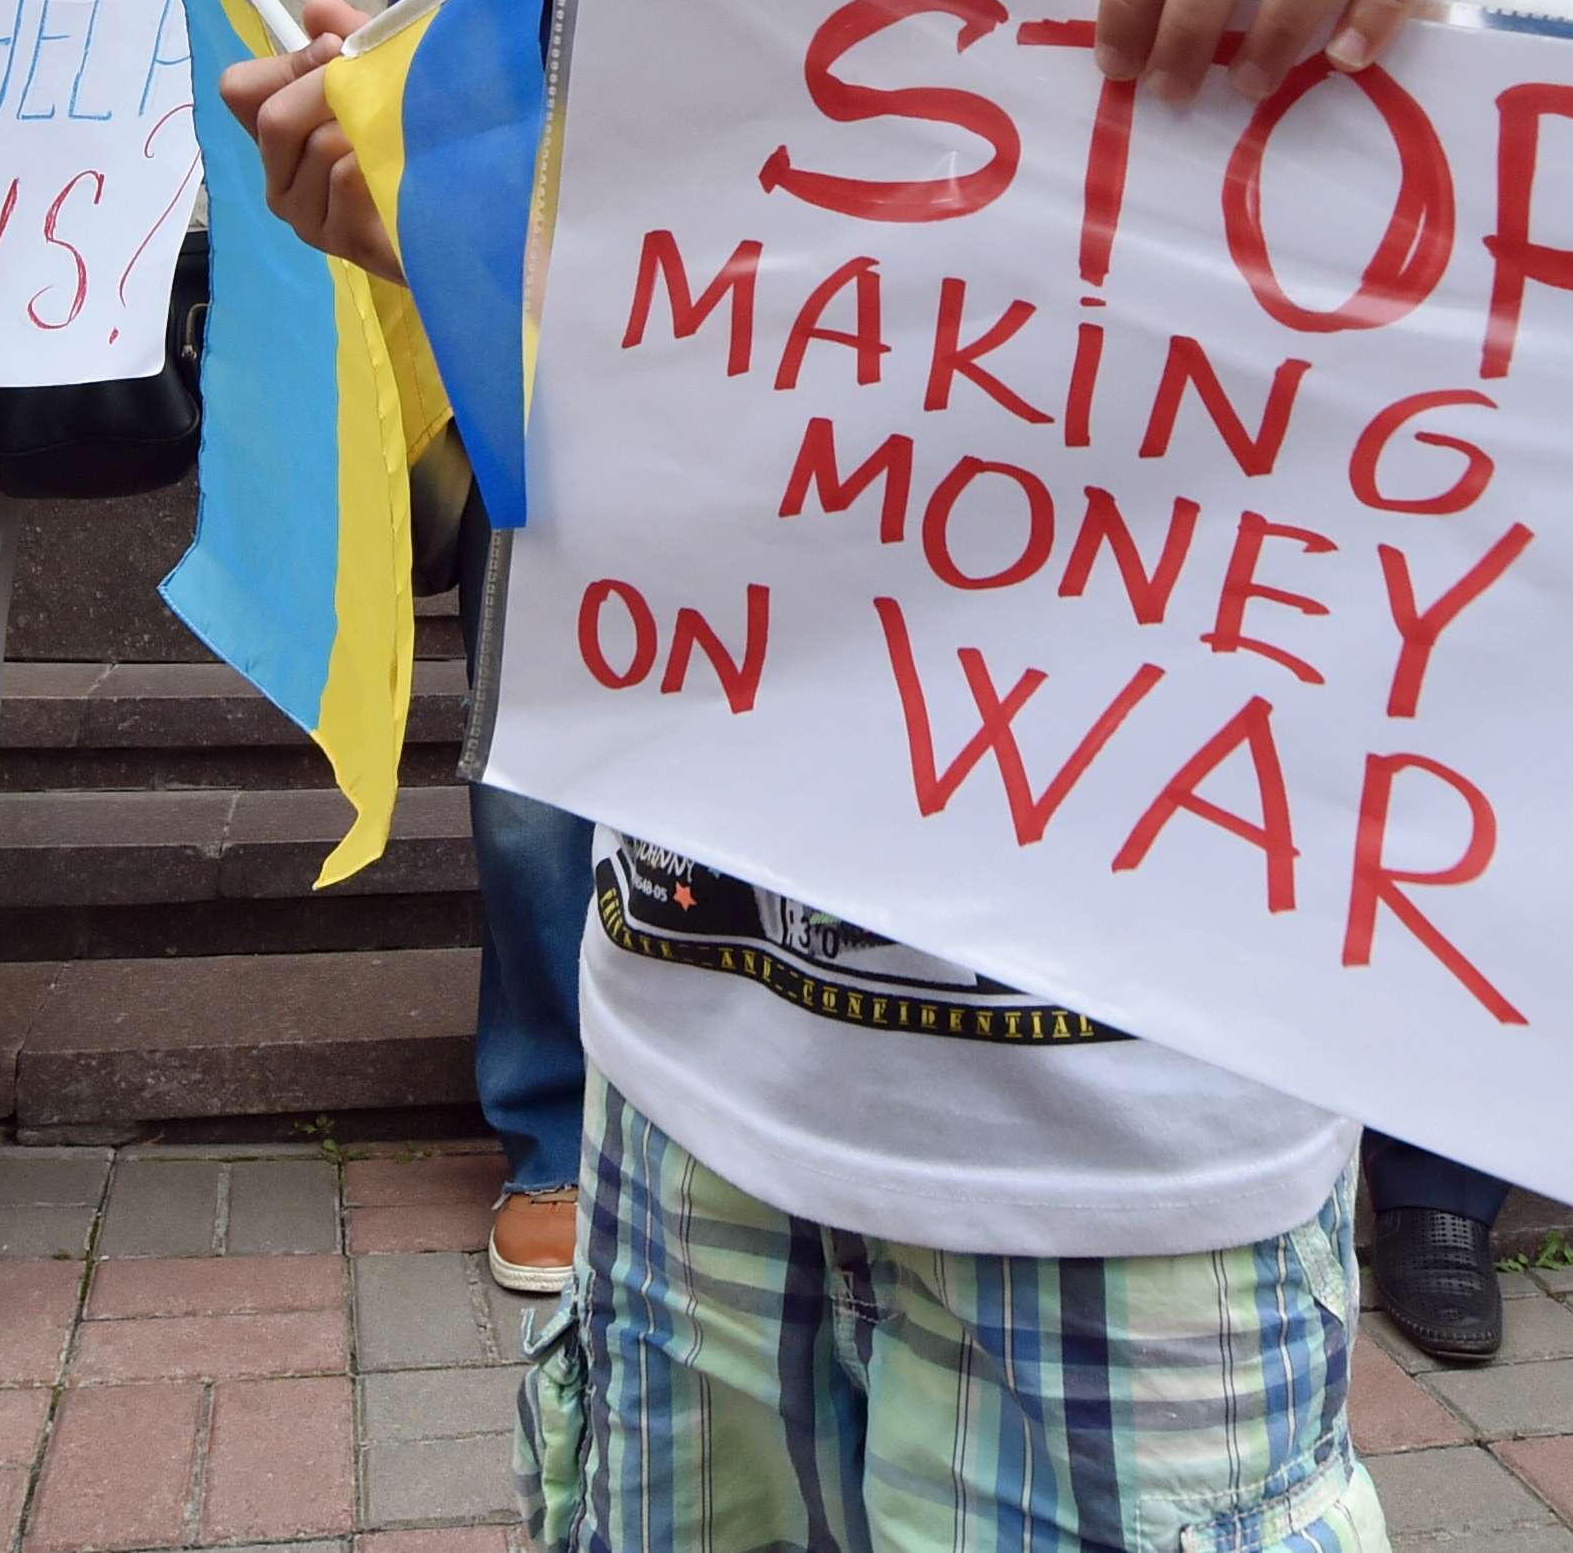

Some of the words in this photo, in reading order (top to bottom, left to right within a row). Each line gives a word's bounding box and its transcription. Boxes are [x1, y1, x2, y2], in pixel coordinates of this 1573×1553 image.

[779, 417, 1533, 719] MONEY
[578, 578, 770, 714] ON
[717, 946, 775, 984] AND
[802, 978, 1095, 1038] CONFIDENTIAL
